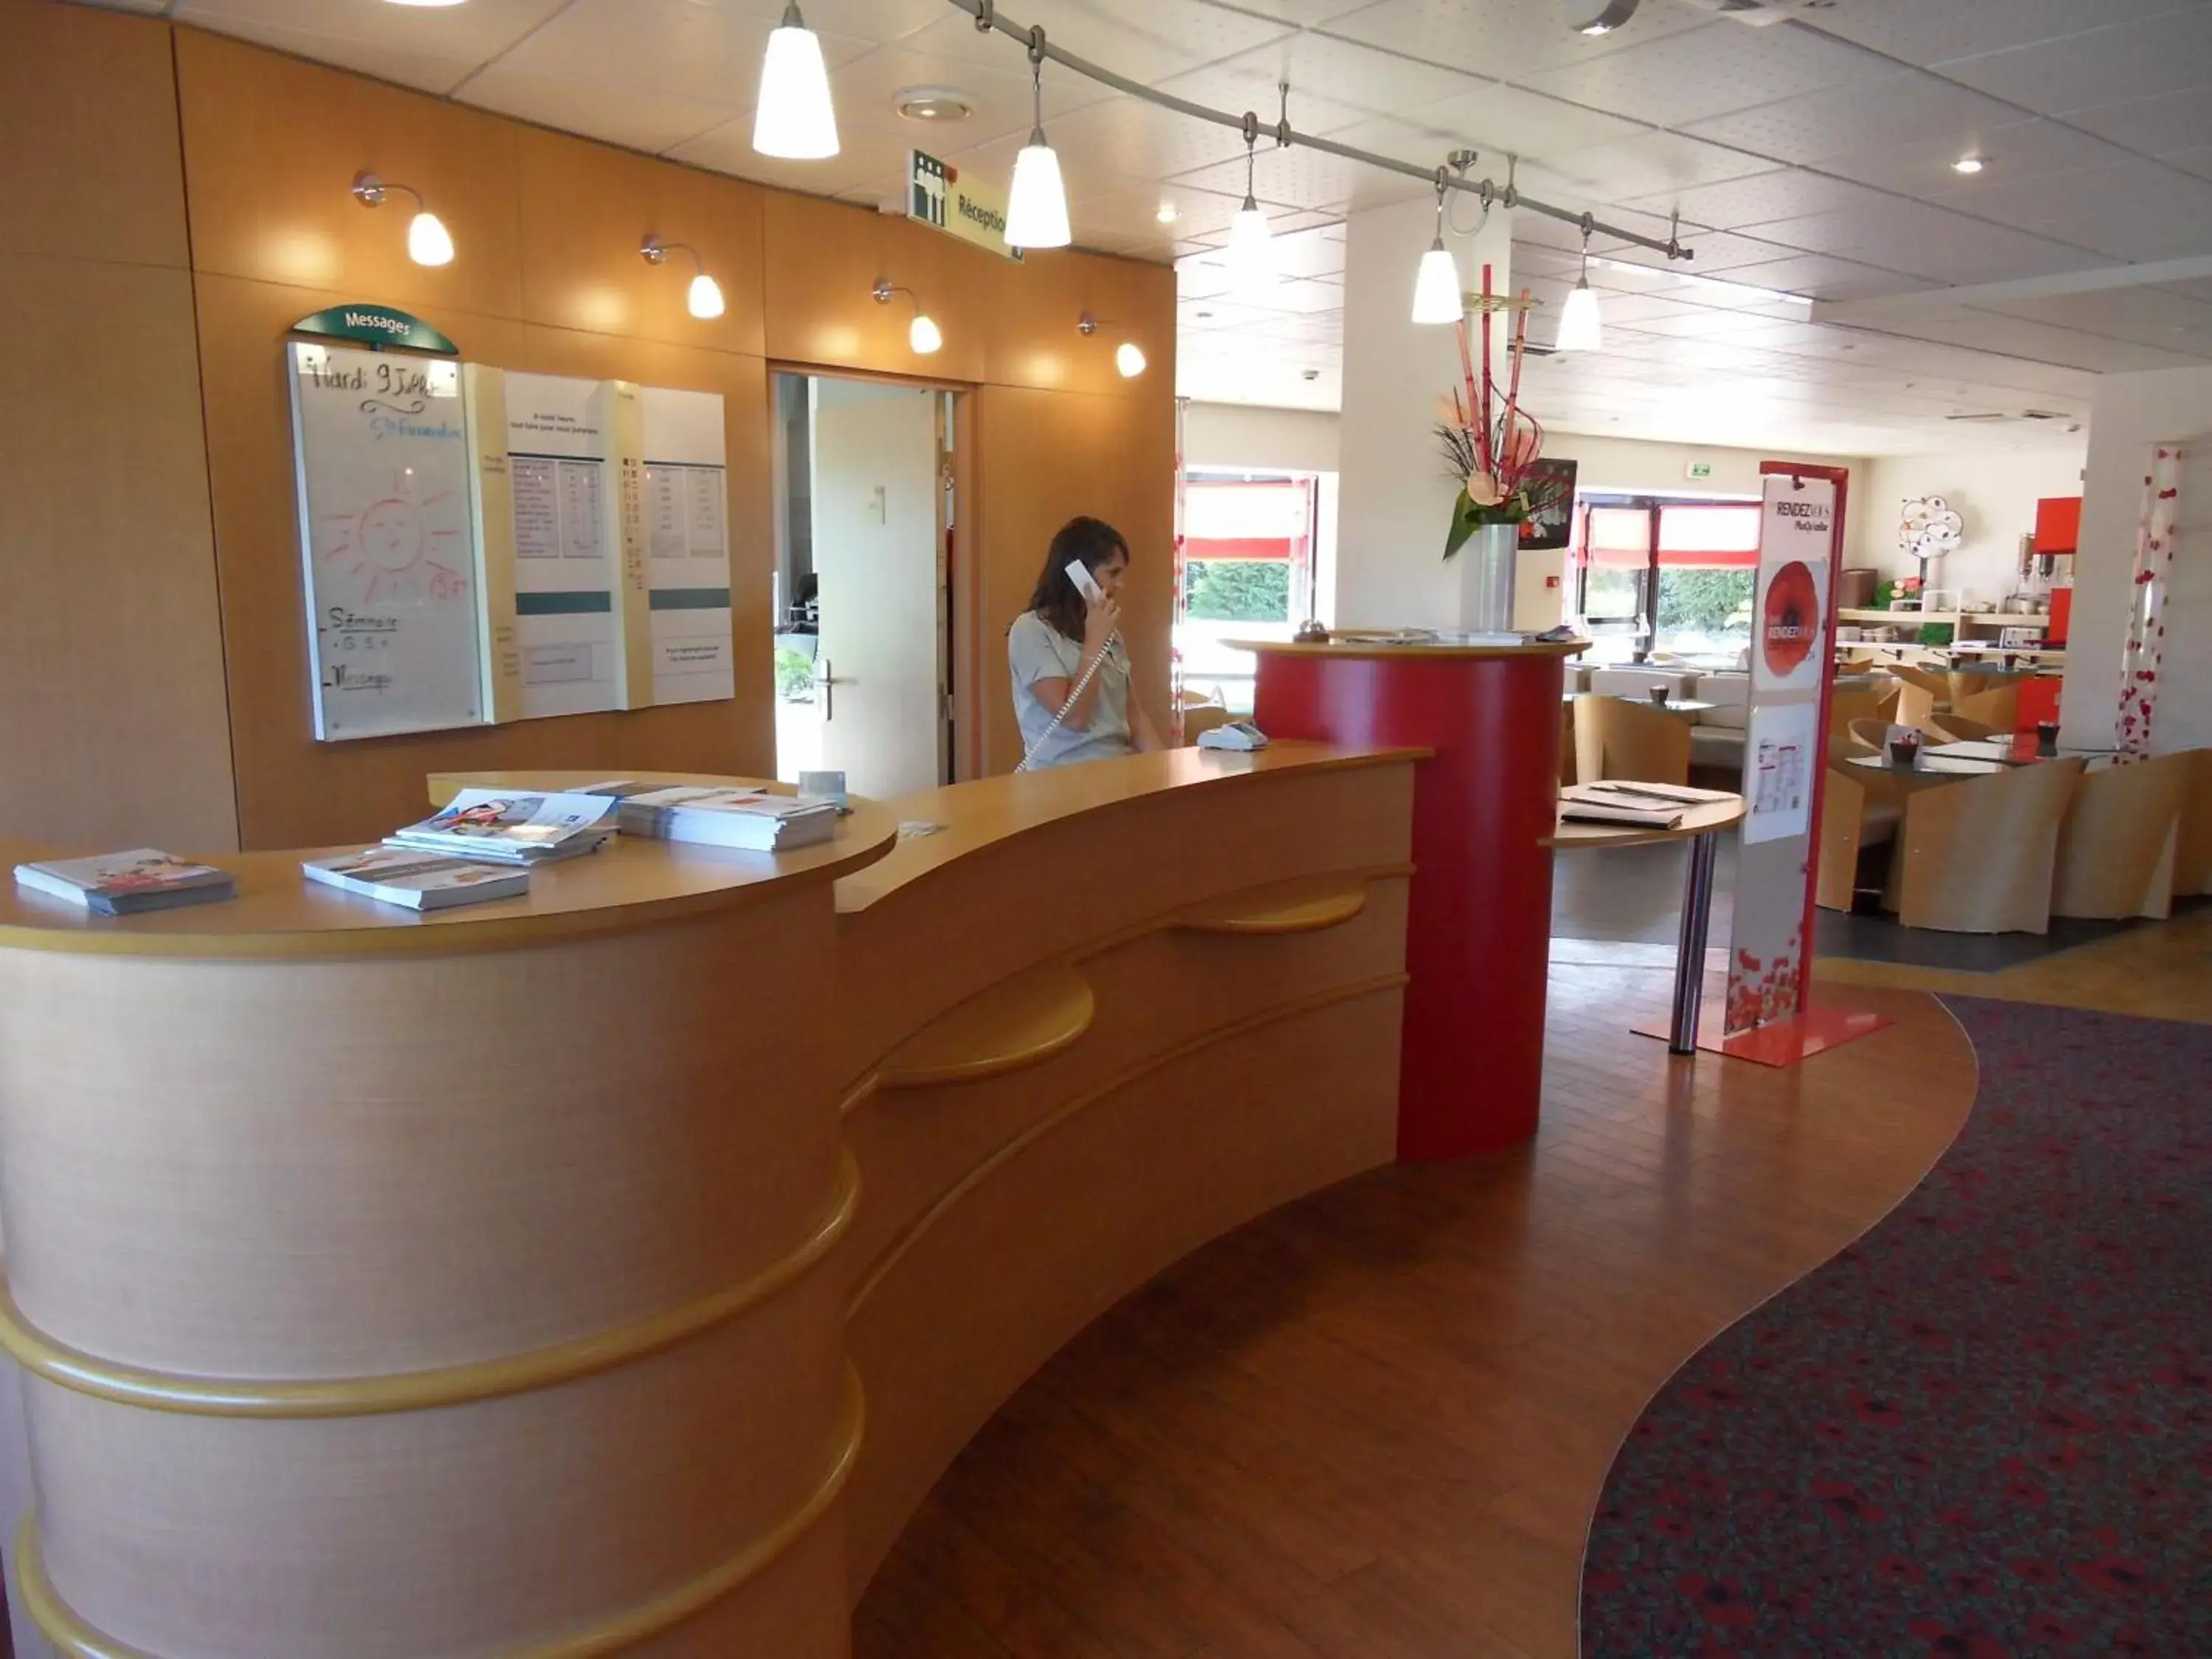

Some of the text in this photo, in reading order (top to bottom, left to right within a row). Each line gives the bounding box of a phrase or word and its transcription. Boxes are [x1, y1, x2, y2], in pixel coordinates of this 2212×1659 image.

[959, 194, 1006, 232] Réceptio
[345, 312, 410, 335] Messages
[377, 364, 391, 394] 9
